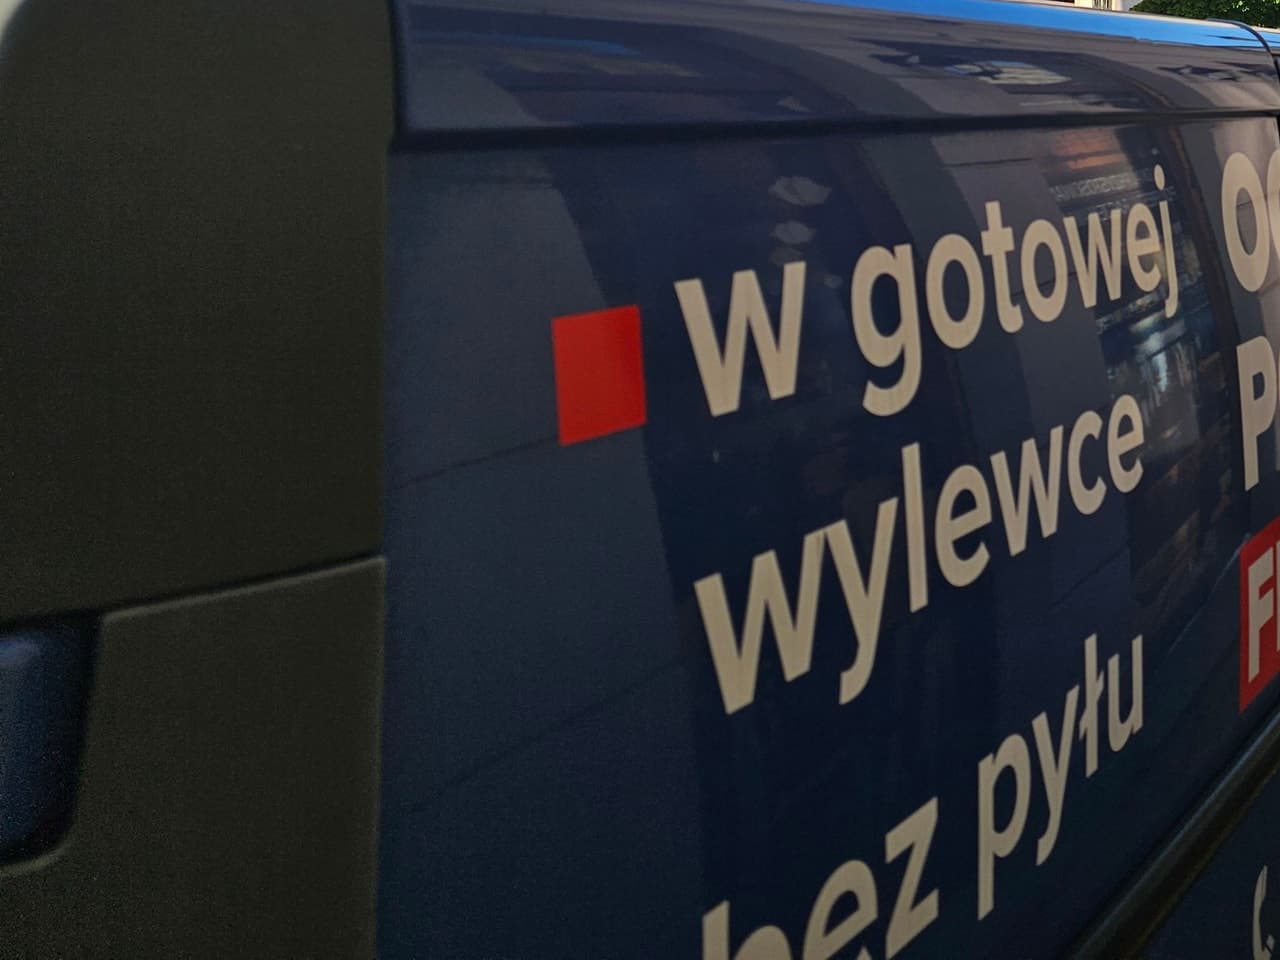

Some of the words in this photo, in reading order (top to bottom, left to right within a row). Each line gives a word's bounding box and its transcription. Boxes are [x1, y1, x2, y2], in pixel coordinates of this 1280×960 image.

[674, 260, 807, 417] w
[850, 164, 1178, 417] gotowej
[693, 394, 1145, 715] wylewce
[977, 632, 1143, 921] pyłu
